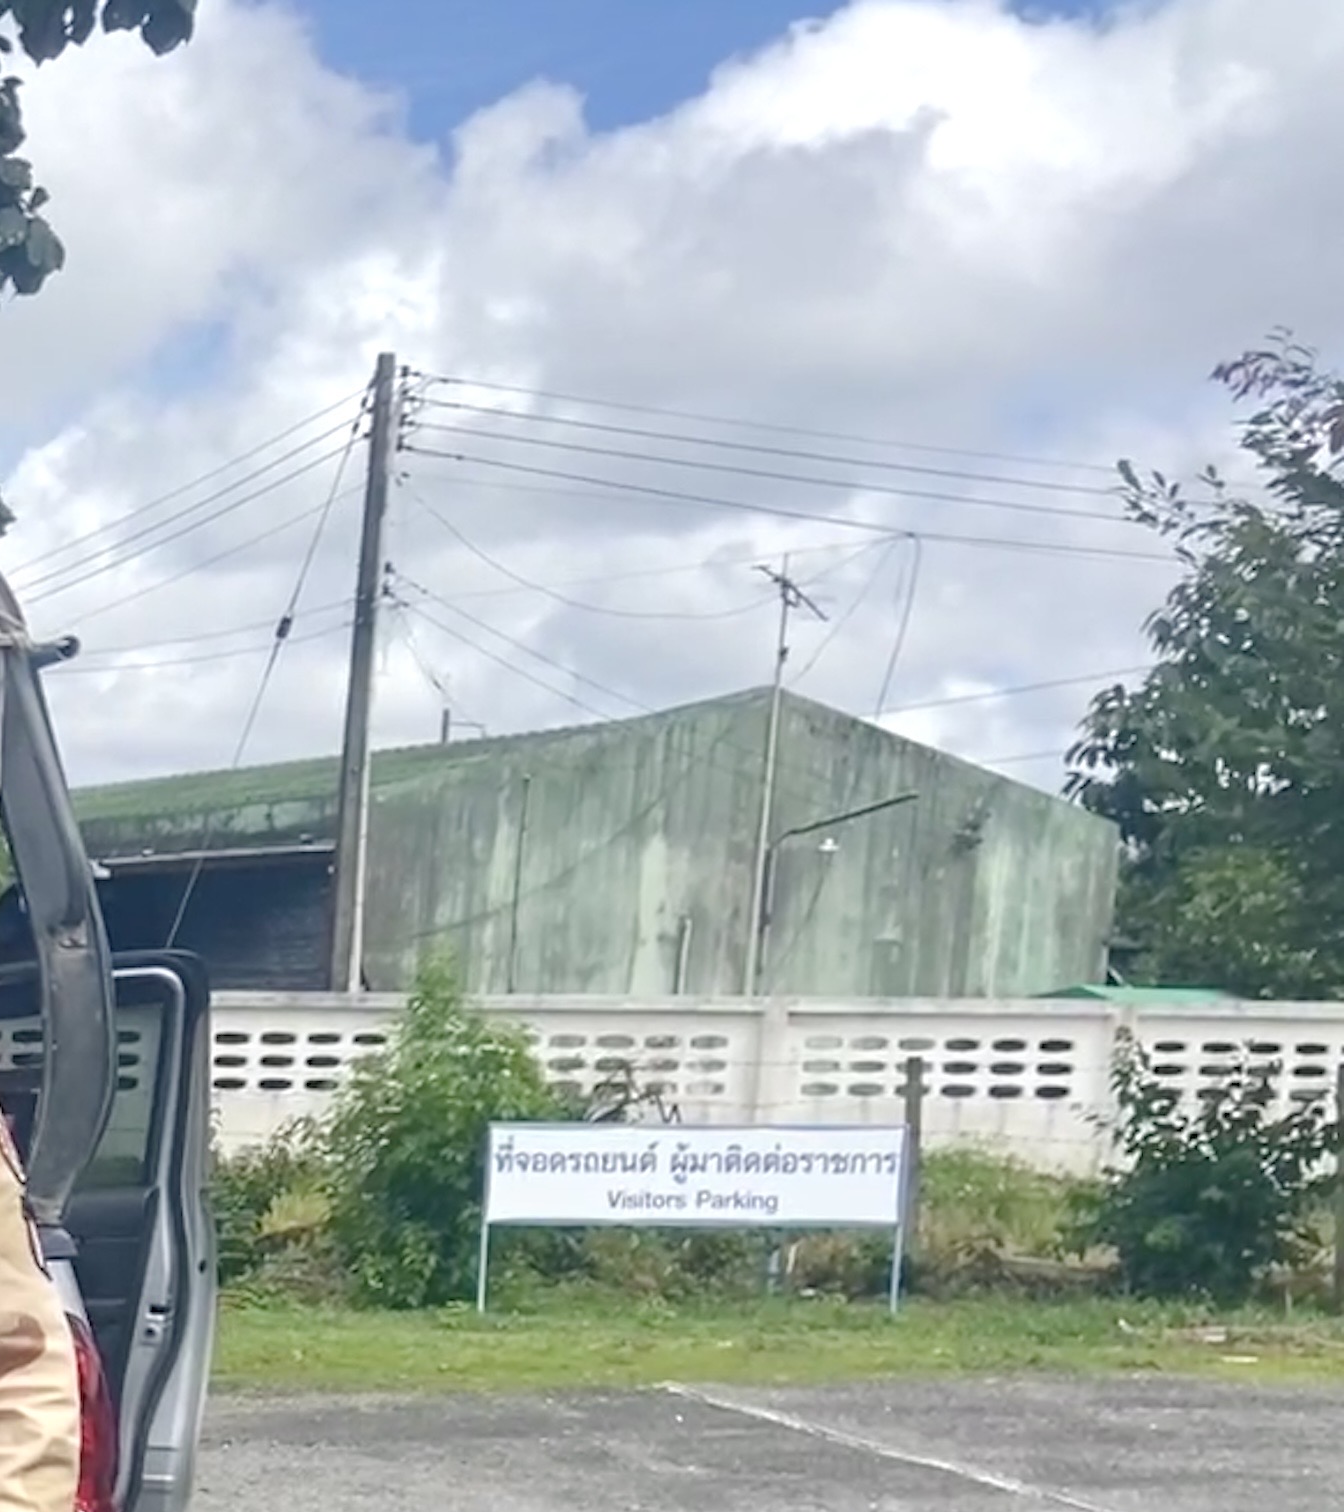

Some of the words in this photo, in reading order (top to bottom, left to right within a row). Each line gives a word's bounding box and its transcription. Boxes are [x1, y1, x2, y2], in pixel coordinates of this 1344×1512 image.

[495, 1137, 658, 1175] ที่จอดรถยนต์
[670, 1142, 898, 1184] ผู้มาติดต่อราชการ
[607, 1190, 688, 1210] Visitors
[696, 1190, 779, 1214] Parking
